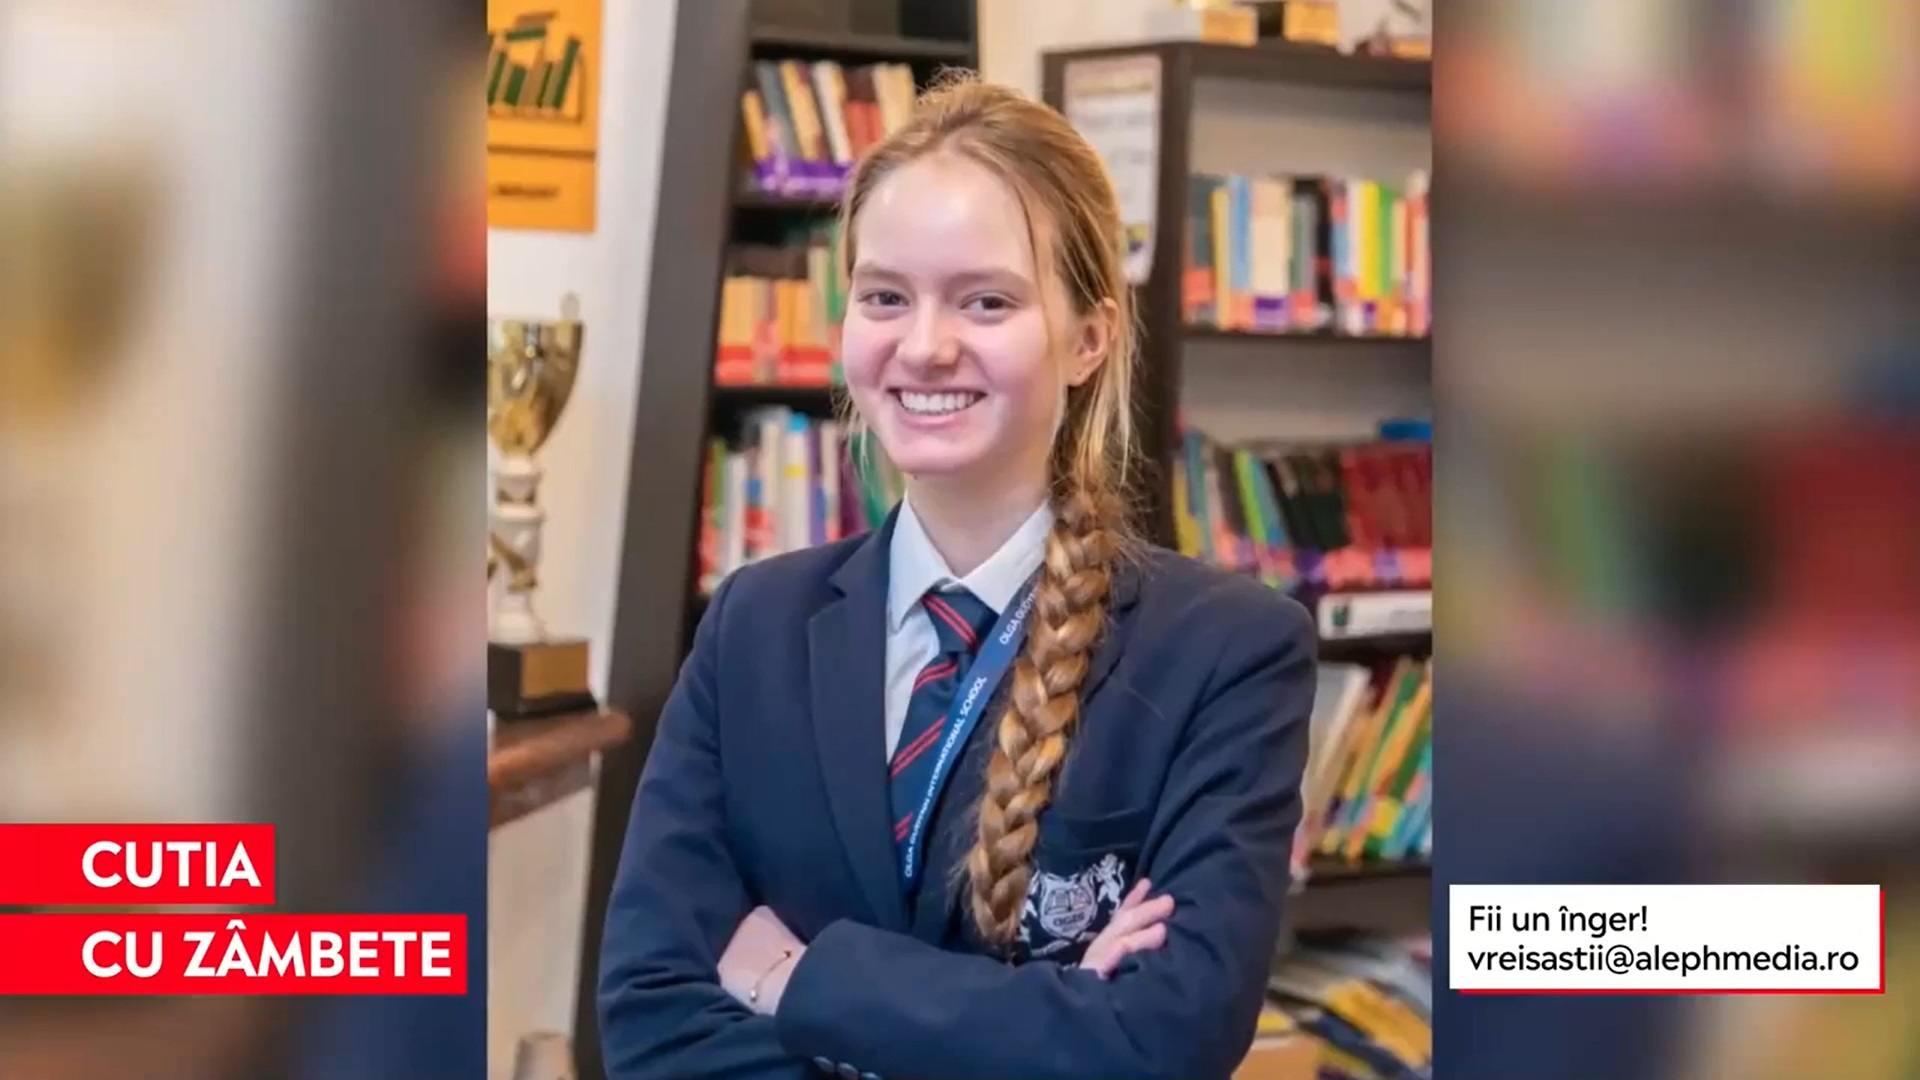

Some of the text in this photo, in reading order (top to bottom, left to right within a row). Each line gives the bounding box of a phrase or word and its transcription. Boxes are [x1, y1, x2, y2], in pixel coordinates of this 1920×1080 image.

[1000, 619, 1020, 645] OLGA
[905, 846, 914, 877] OLGA
[927, 718, 966, 797] INTERNATIONAL
[960, 676, 987, 716] SCHOOL
